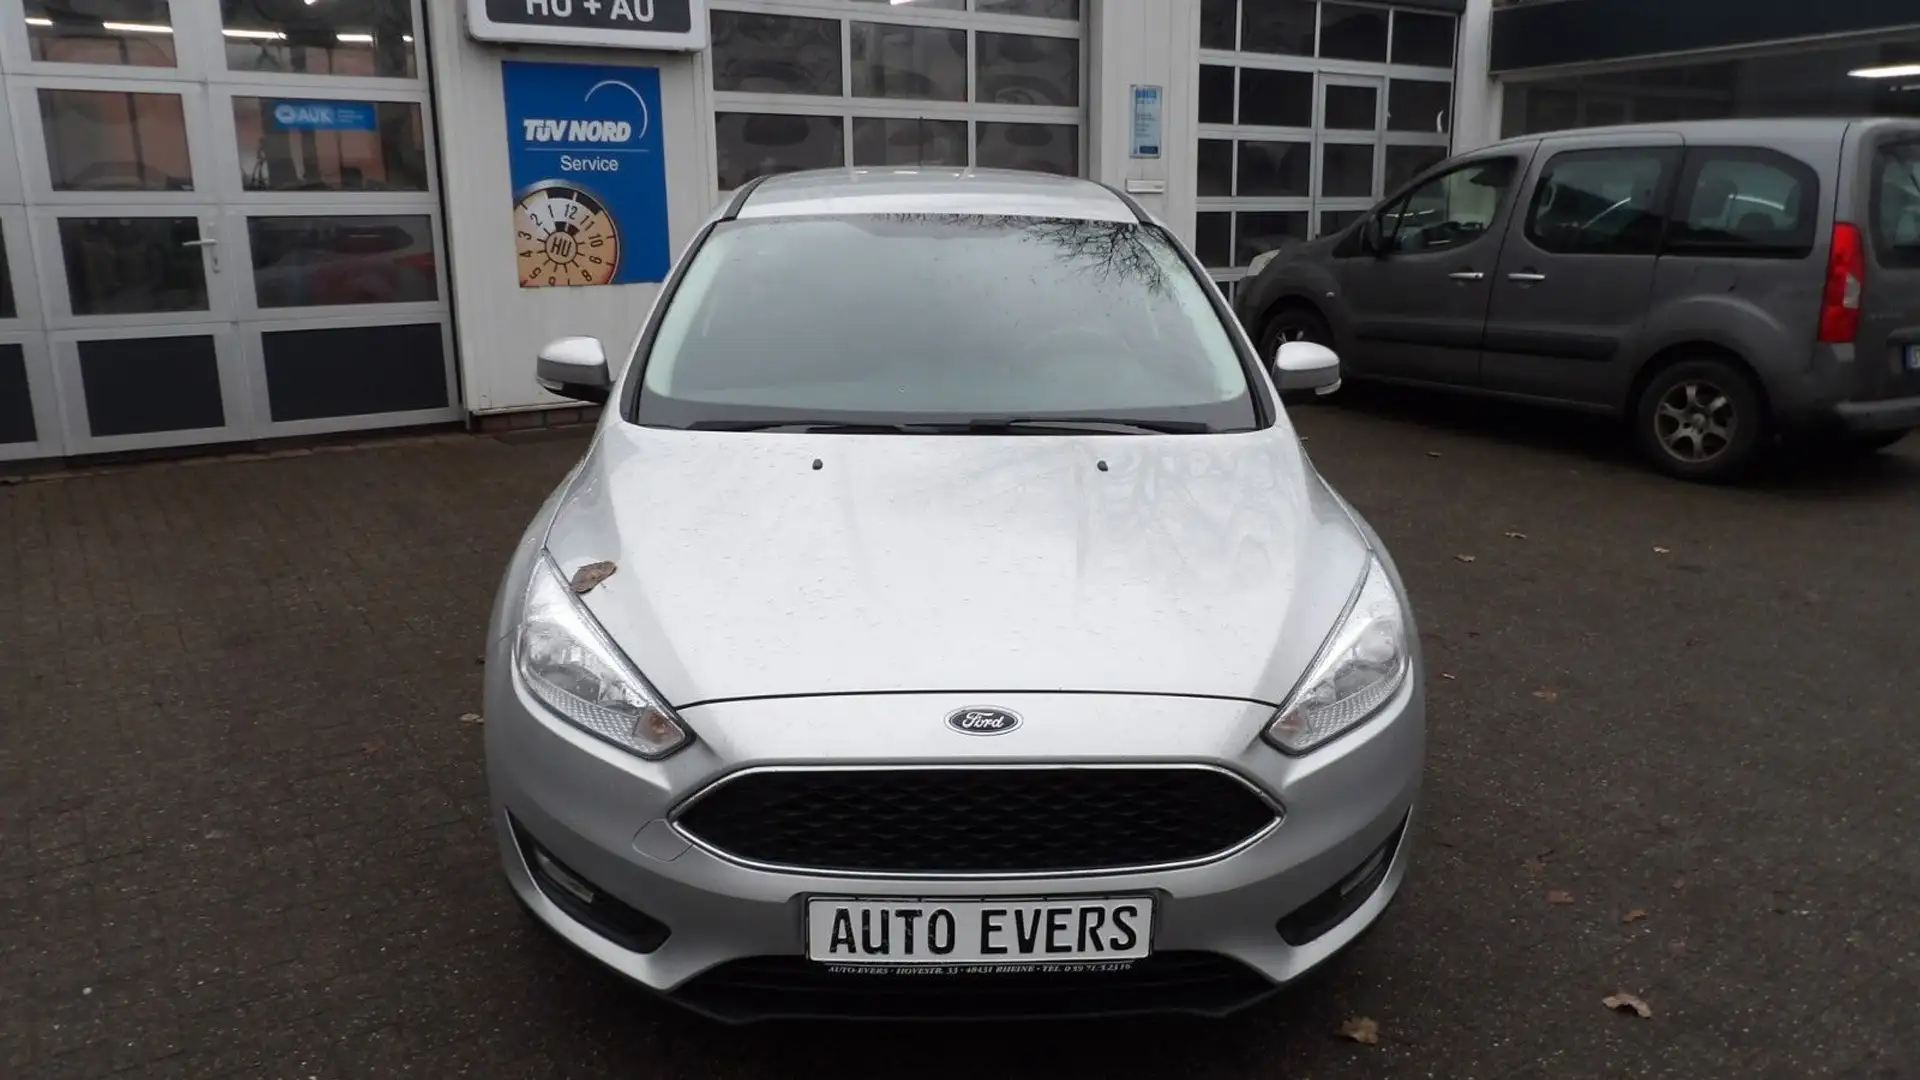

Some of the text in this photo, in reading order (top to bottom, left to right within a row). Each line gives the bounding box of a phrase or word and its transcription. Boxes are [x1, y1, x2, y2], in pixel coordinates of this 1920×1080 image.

[527, 0, 572, 17] HU
[610, 0, 654, 22] AU
[523, 119, 632, 142] TÜV NORD
[560, 155, 619, 171] Service
[564, 203, 578, 220] 12
[579, 215, 595, 231] 11
[550, 236, 572, 257] HU
[588, 234, 604, 248] 10
[962, 711, 1004, 728] Ford
[829, 905, 1138, 955] AUTO EVERS
[996, 964, 1034, 973] RHEINE
